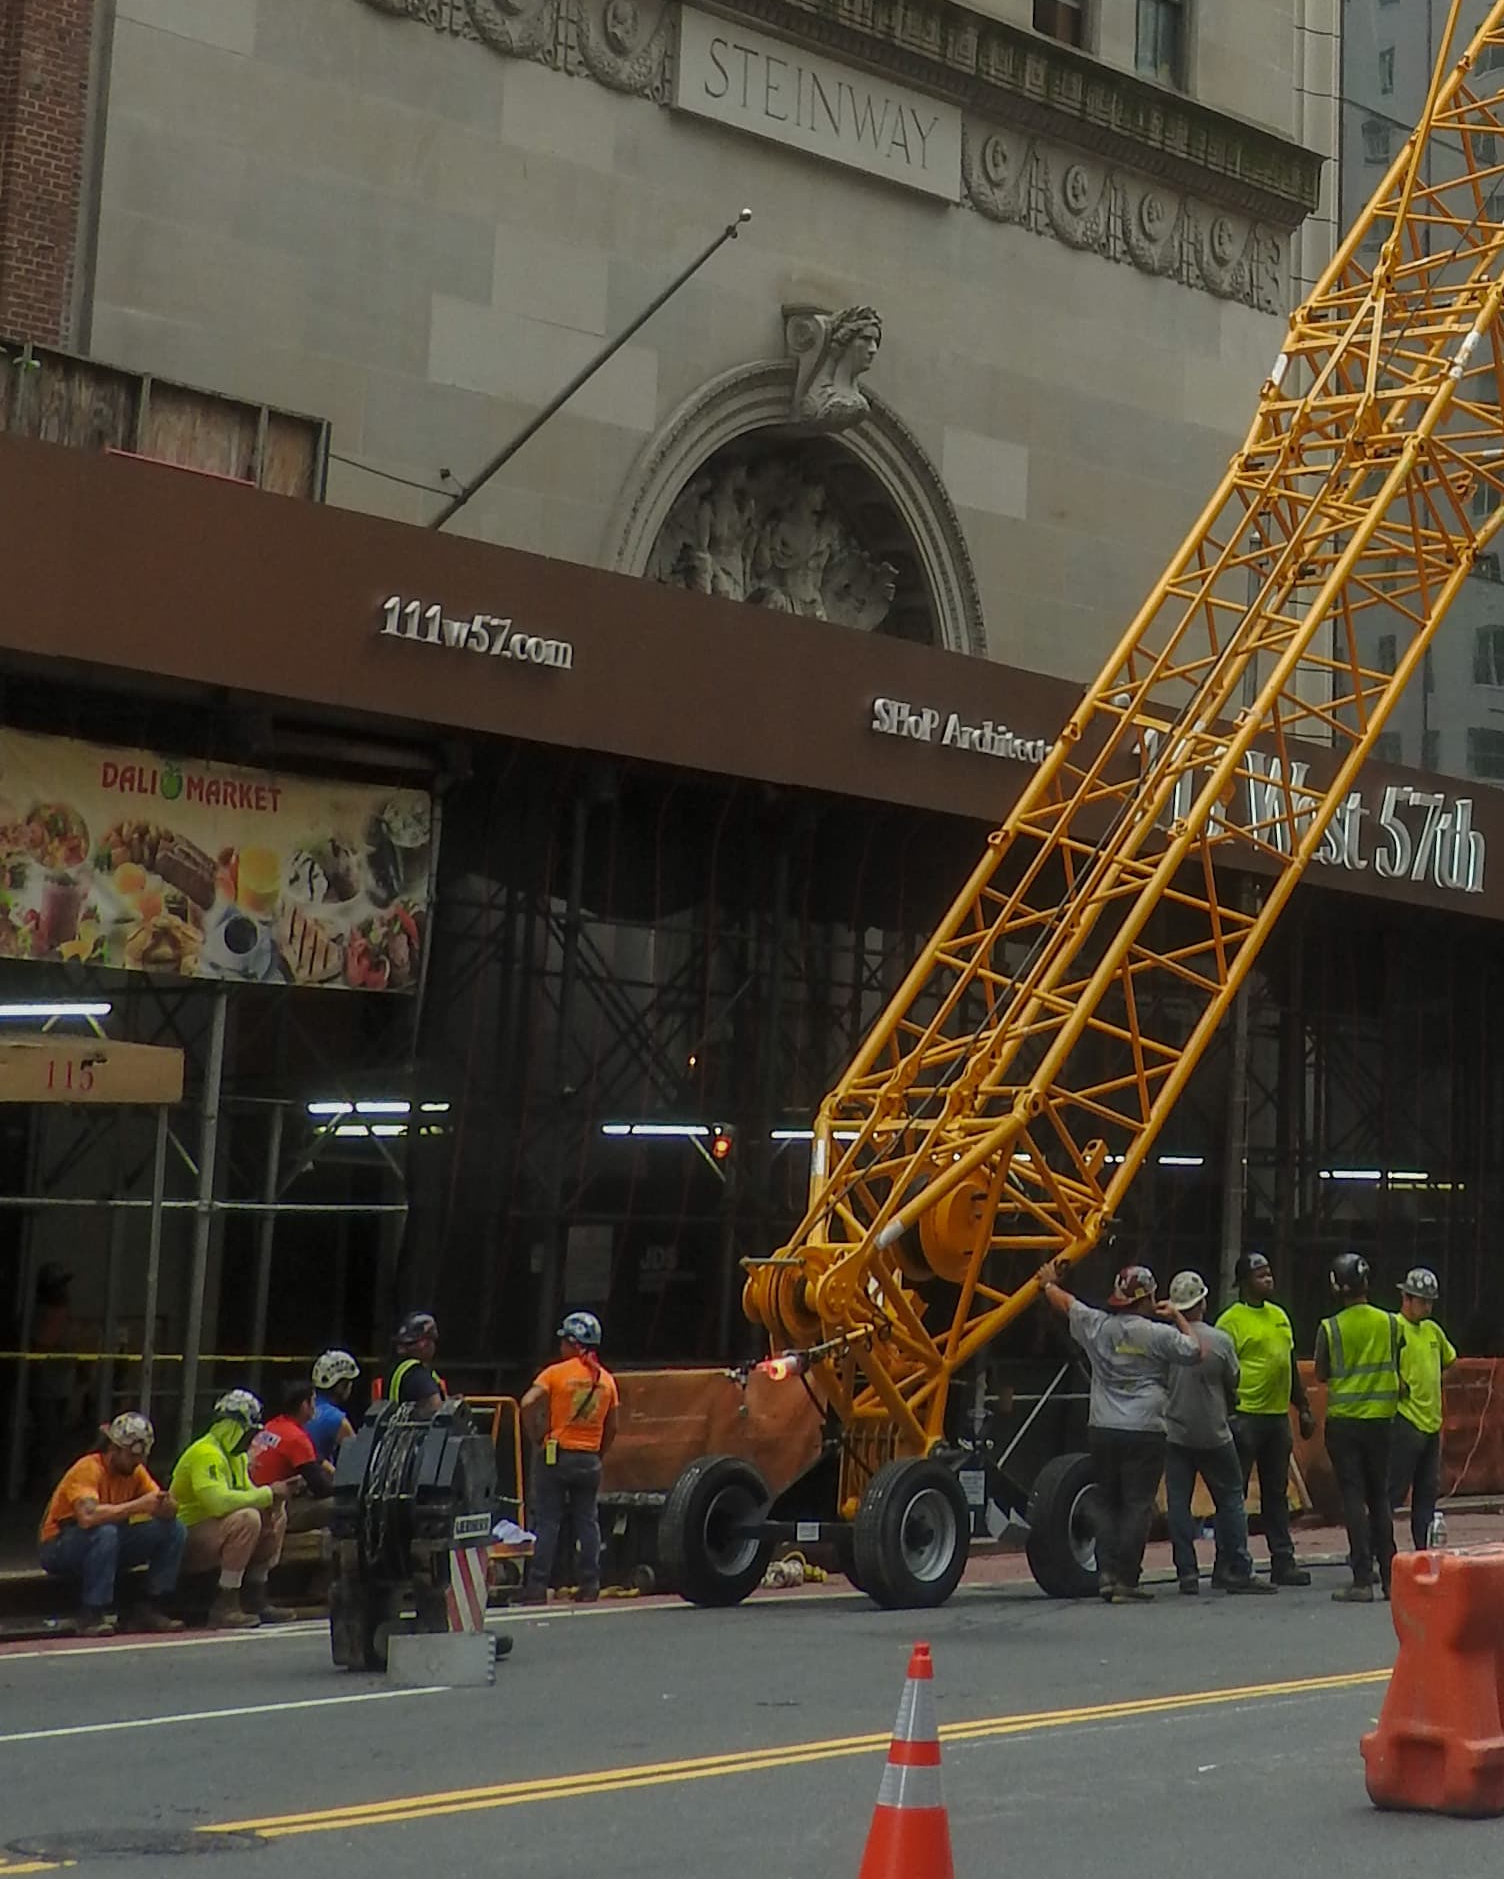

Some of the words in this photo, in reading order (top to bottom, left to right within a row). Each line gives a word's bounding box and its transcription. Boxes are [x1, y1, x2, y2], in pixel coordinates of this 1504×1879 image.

[704, 37, 940, 169] STEINWAY
[380, 596, 573, 669] 111w57.com
[873, 697, 940, 742] SHoP
[101, 761, 157, 796] DALI
[186, 775, 283, 813] MARKET
[1375, 786, 1485, 894] 57th
